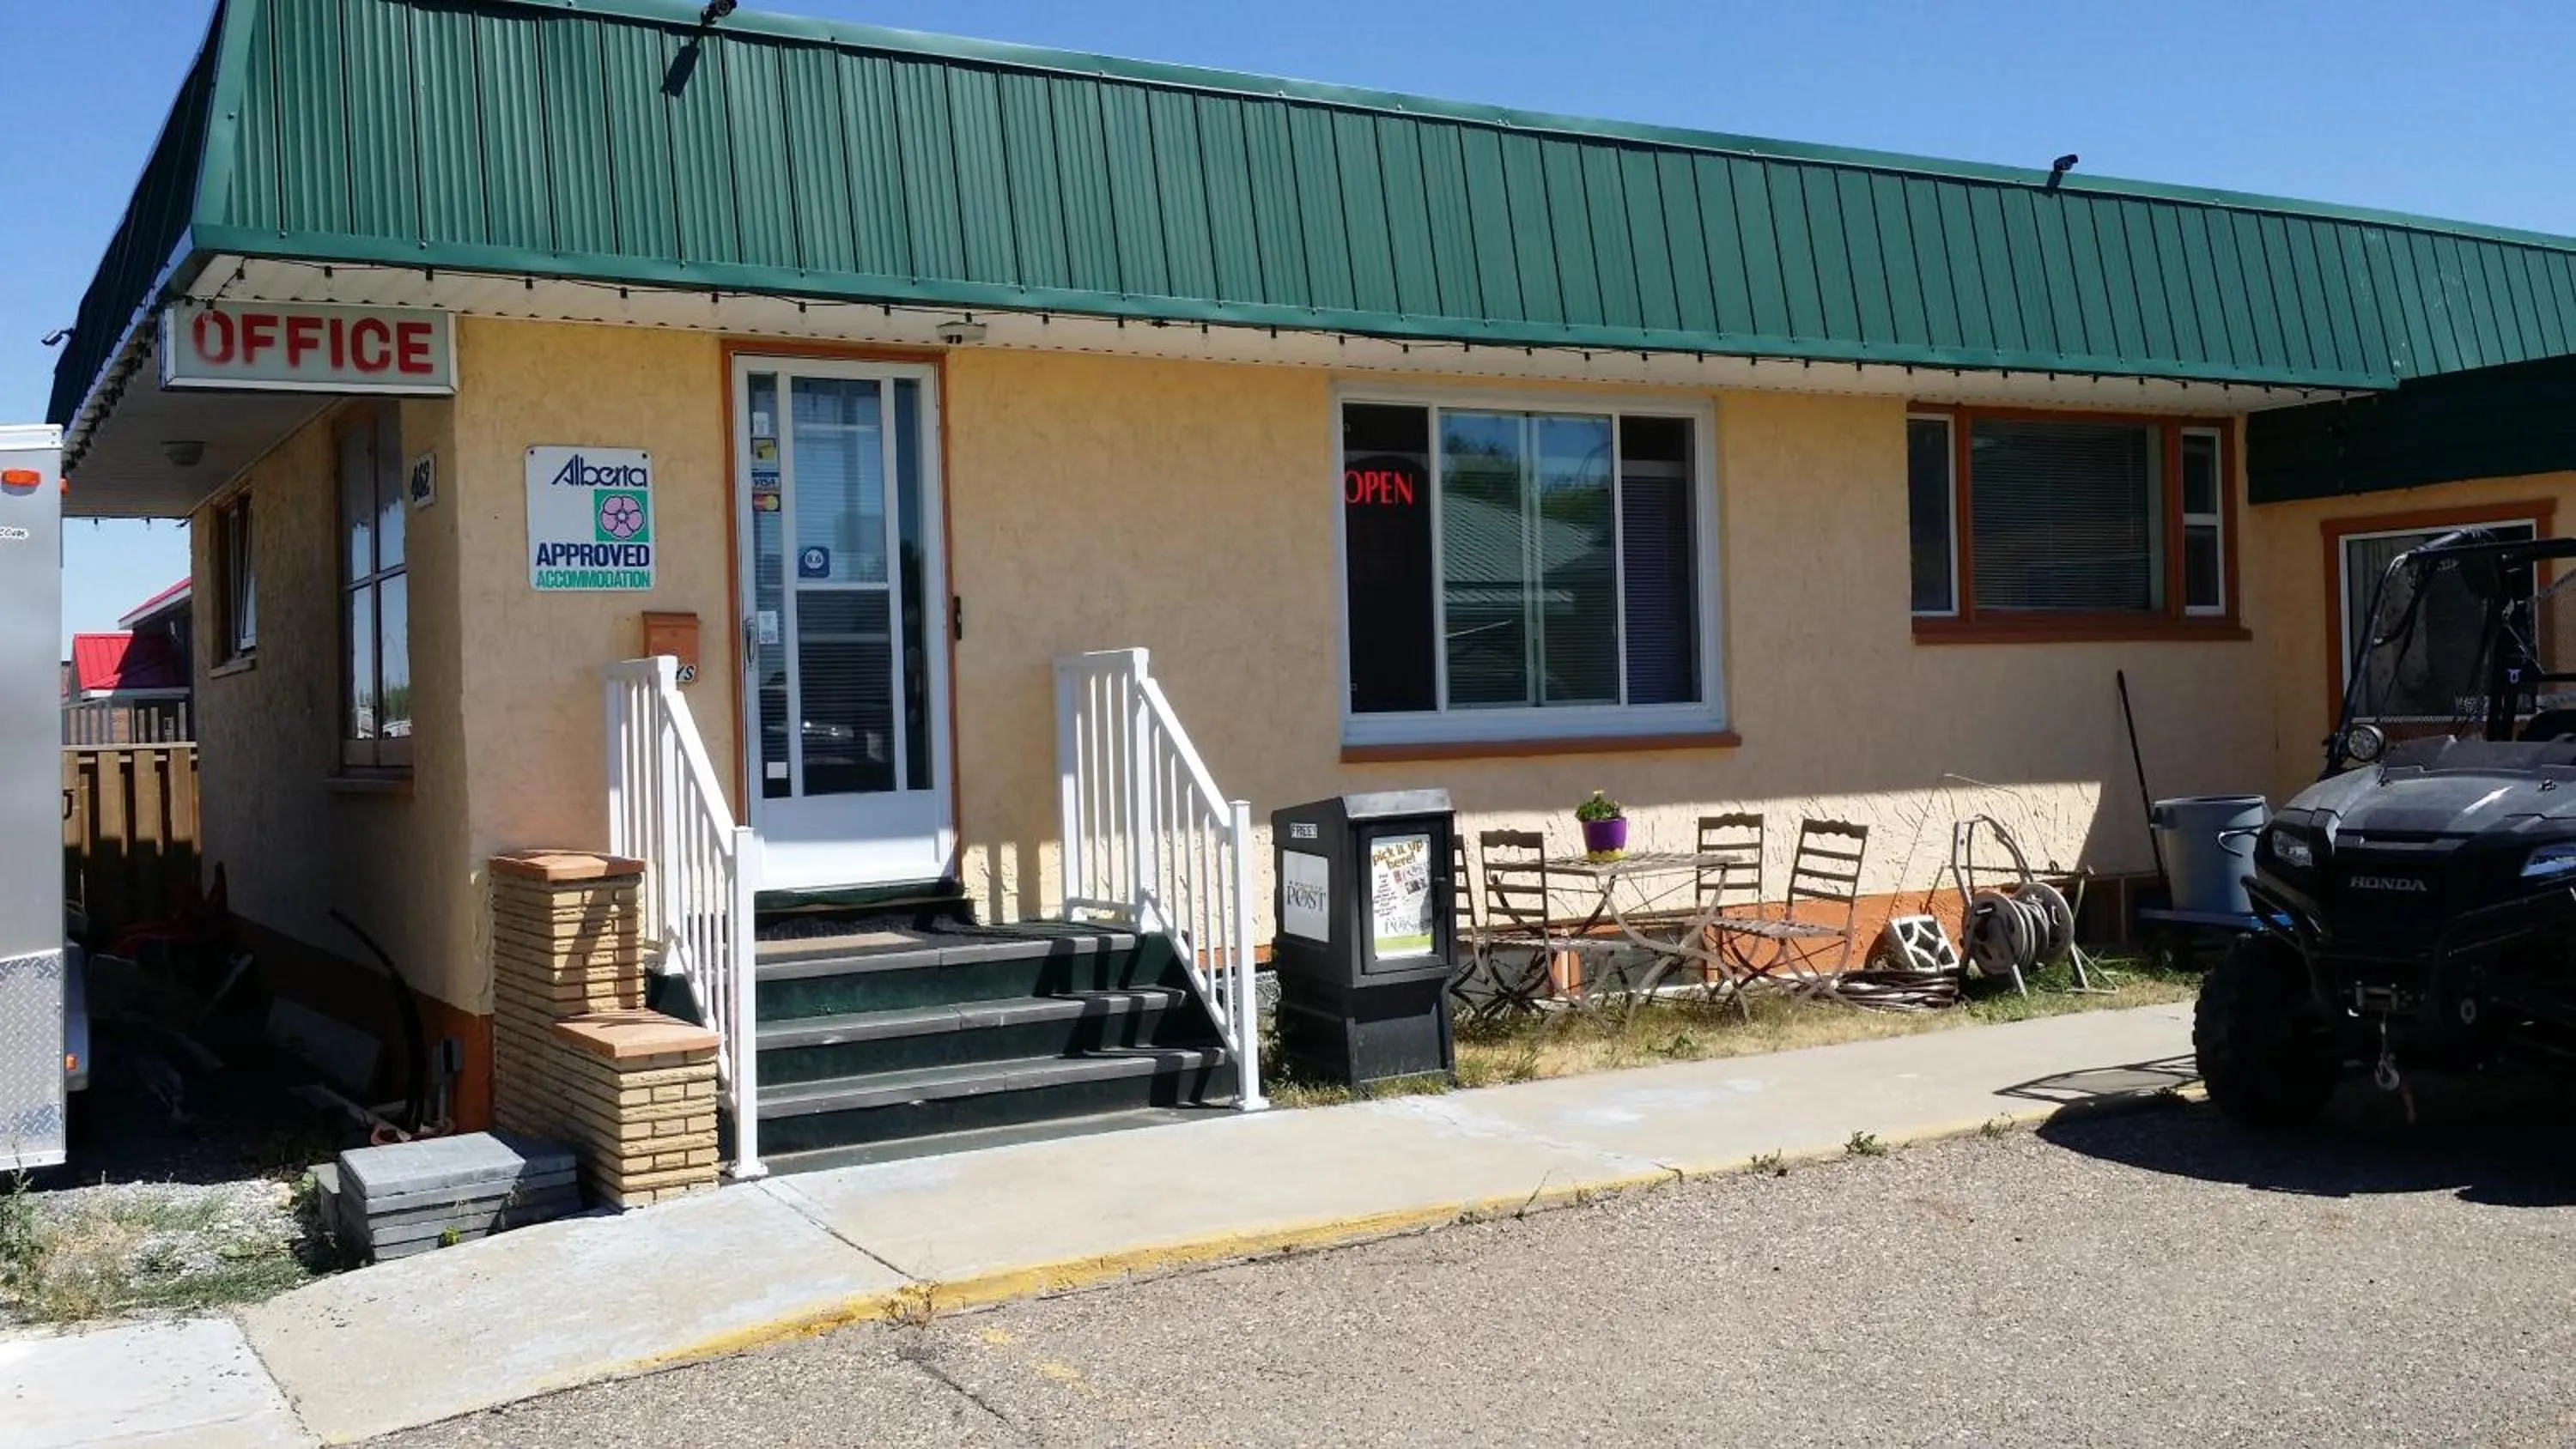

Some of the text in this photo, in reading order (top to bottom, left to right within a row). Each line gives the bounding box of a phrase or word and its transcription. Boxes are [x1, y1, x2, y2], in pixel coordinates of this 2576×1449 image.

[192, 309, 434, 373] OFFICE
[551, 454, 647, 488] Alberta
[1346, 470, 1413, 505] OPEN
[536, 543, 650, 567] APPROVED
[536, 570, 650, 588] ACCOMMODATION
[2348, 876, 2427, 892] HONDA
[1286, 885, 1327, 912] POST
